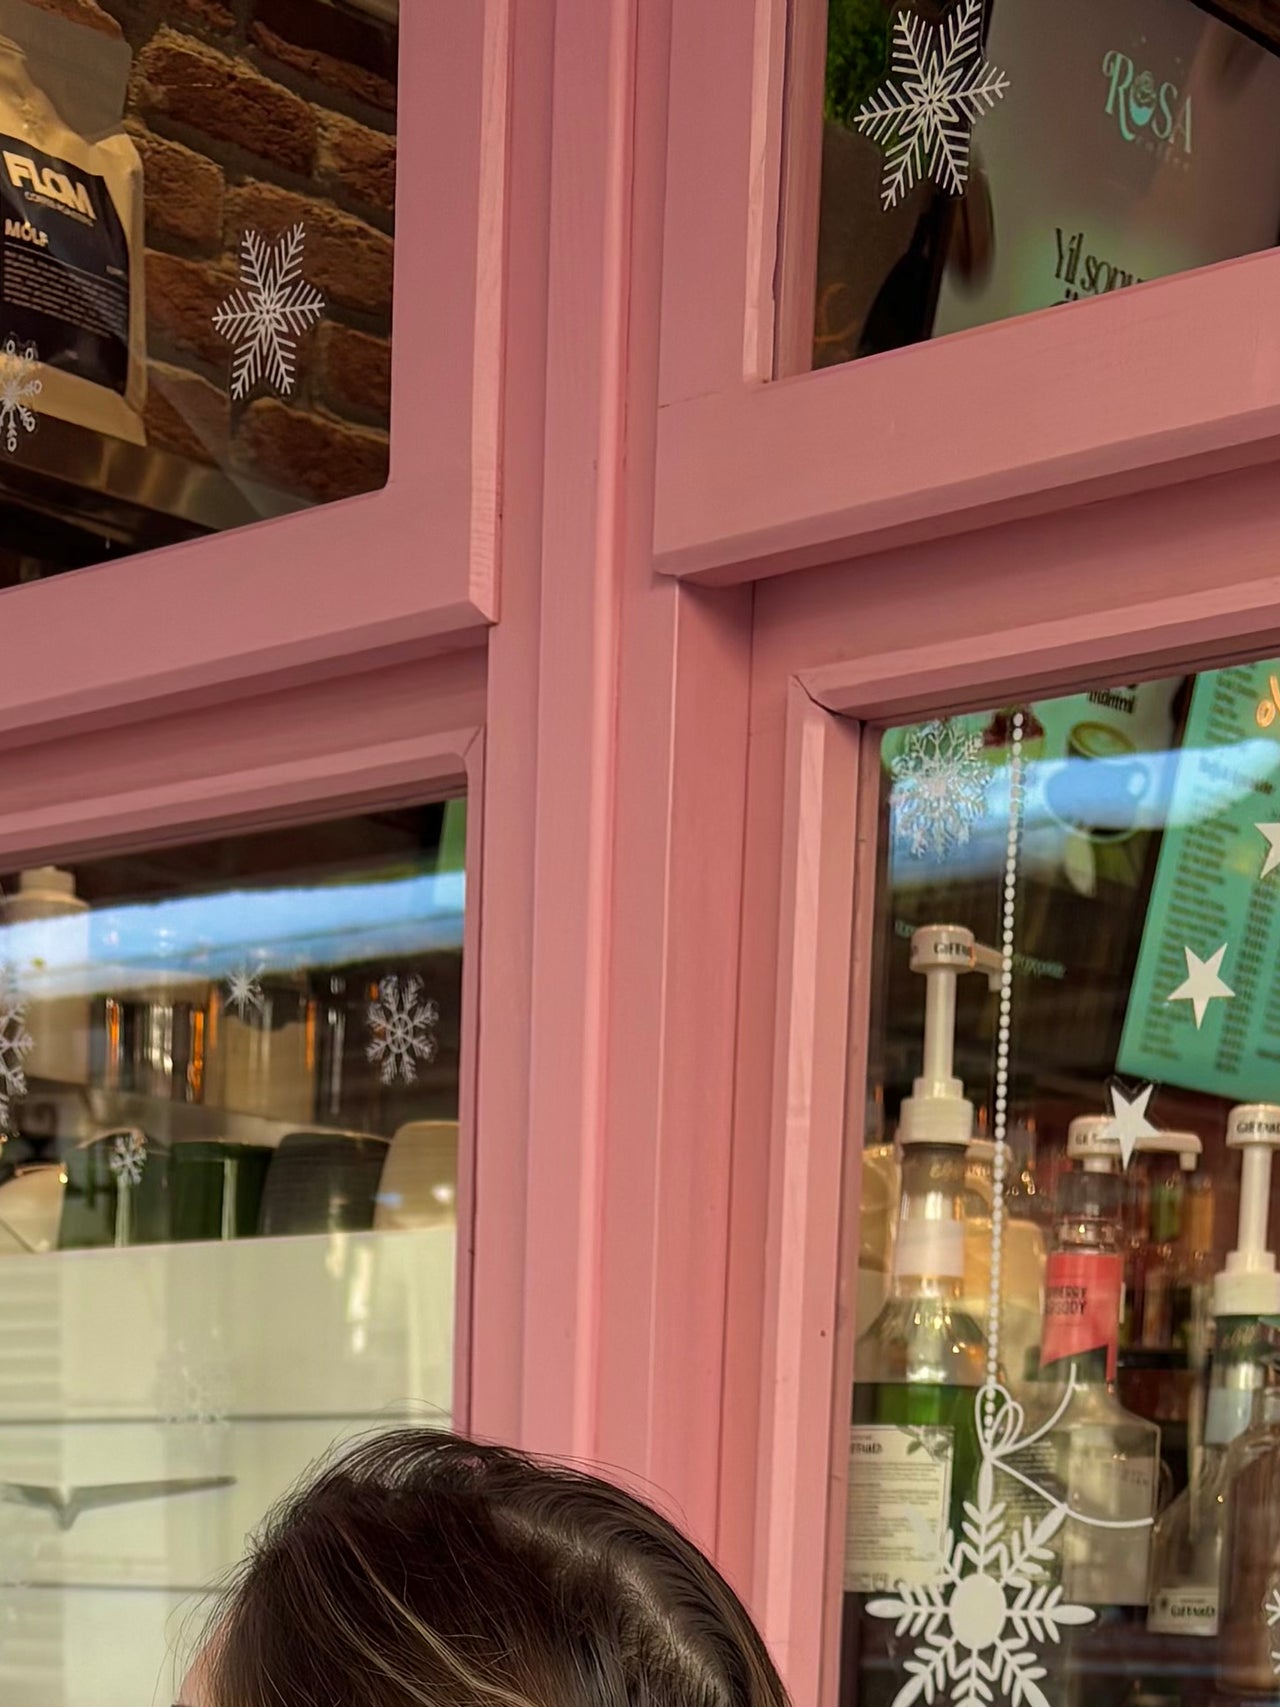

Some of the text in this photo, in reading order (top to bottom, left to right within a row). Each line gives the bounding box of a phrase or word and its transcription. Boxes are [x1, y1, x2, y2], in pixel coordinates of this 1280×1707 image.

[1102, 50, 1191, 154] ROSA
[2, 150, 97, 220] FLOM
[4, 218, 49, 247] MOLF
